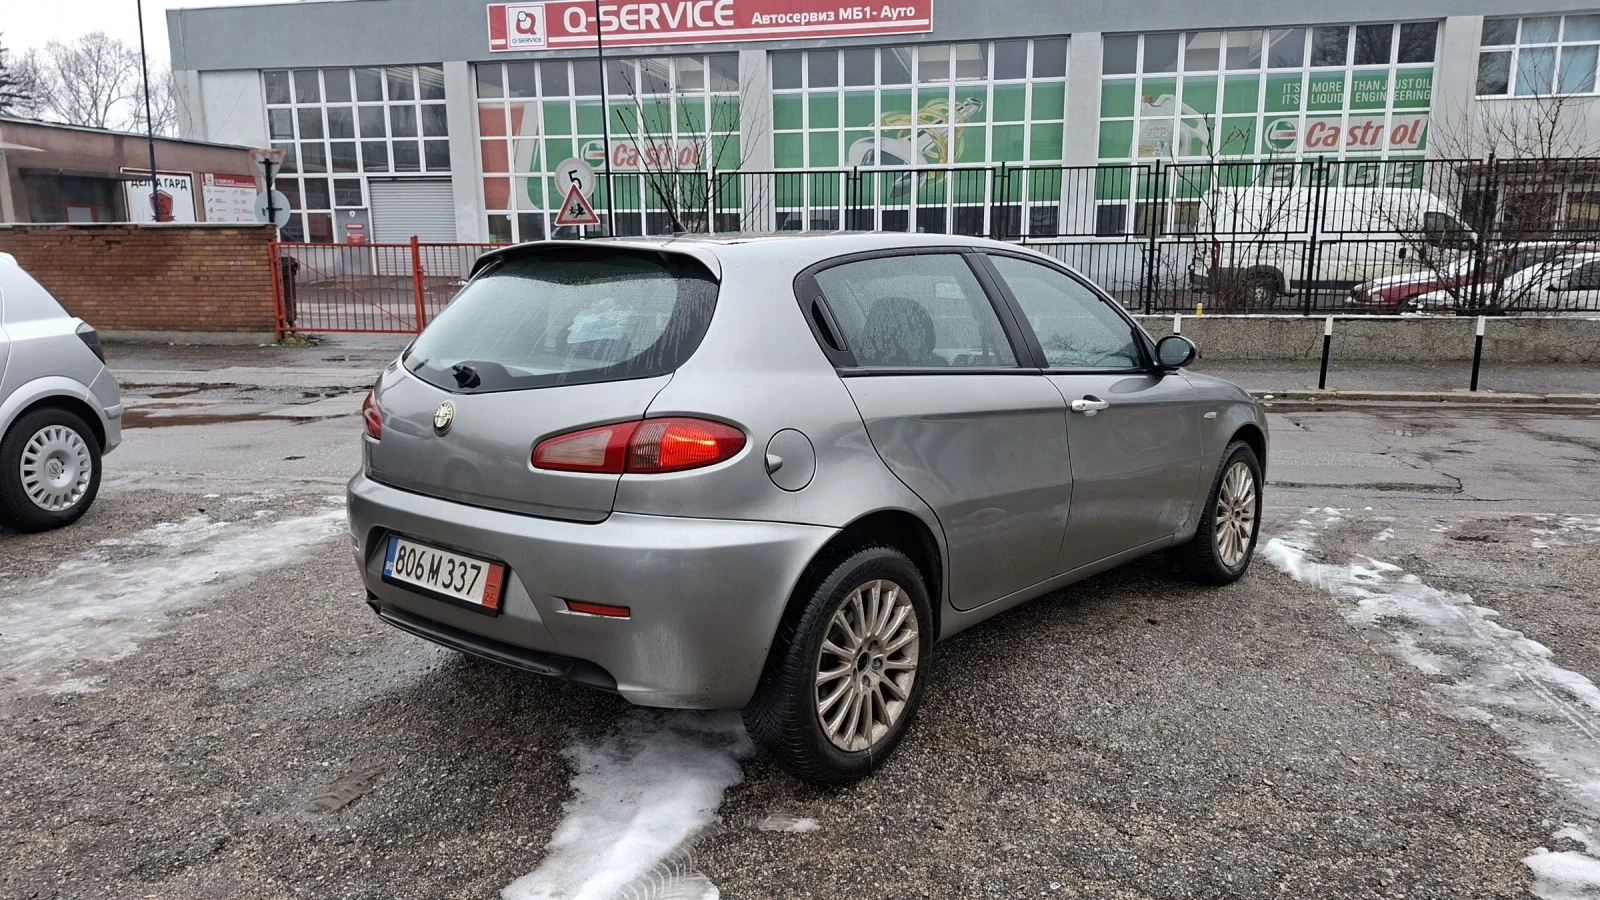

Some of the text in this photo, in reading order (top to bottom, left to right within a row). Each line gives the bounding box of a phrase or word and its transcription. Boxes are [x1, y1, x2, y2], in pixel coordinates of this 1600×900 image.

[563, 0, 735, 33] Q-SERVICE
[751, 11, 835, 25] Автосервиз
[1283, 83, 1301, 94] IT'S
[1312, 82, 1341, 92] MORE
[1354, 80, 1381, 91] THAN
[1415, 78, 1432, 89] OIL
[1282, 90, 1431, 105] IT'S LIQUID ENGINEERING
[1305, 119, 1421, 148] Castrol
[613, 143, 701, 167] Castrol
[164, 178, 187, 191] ГАРД
[568, 169, 582, 190] 5
[484, 591, 495, 603] 26
